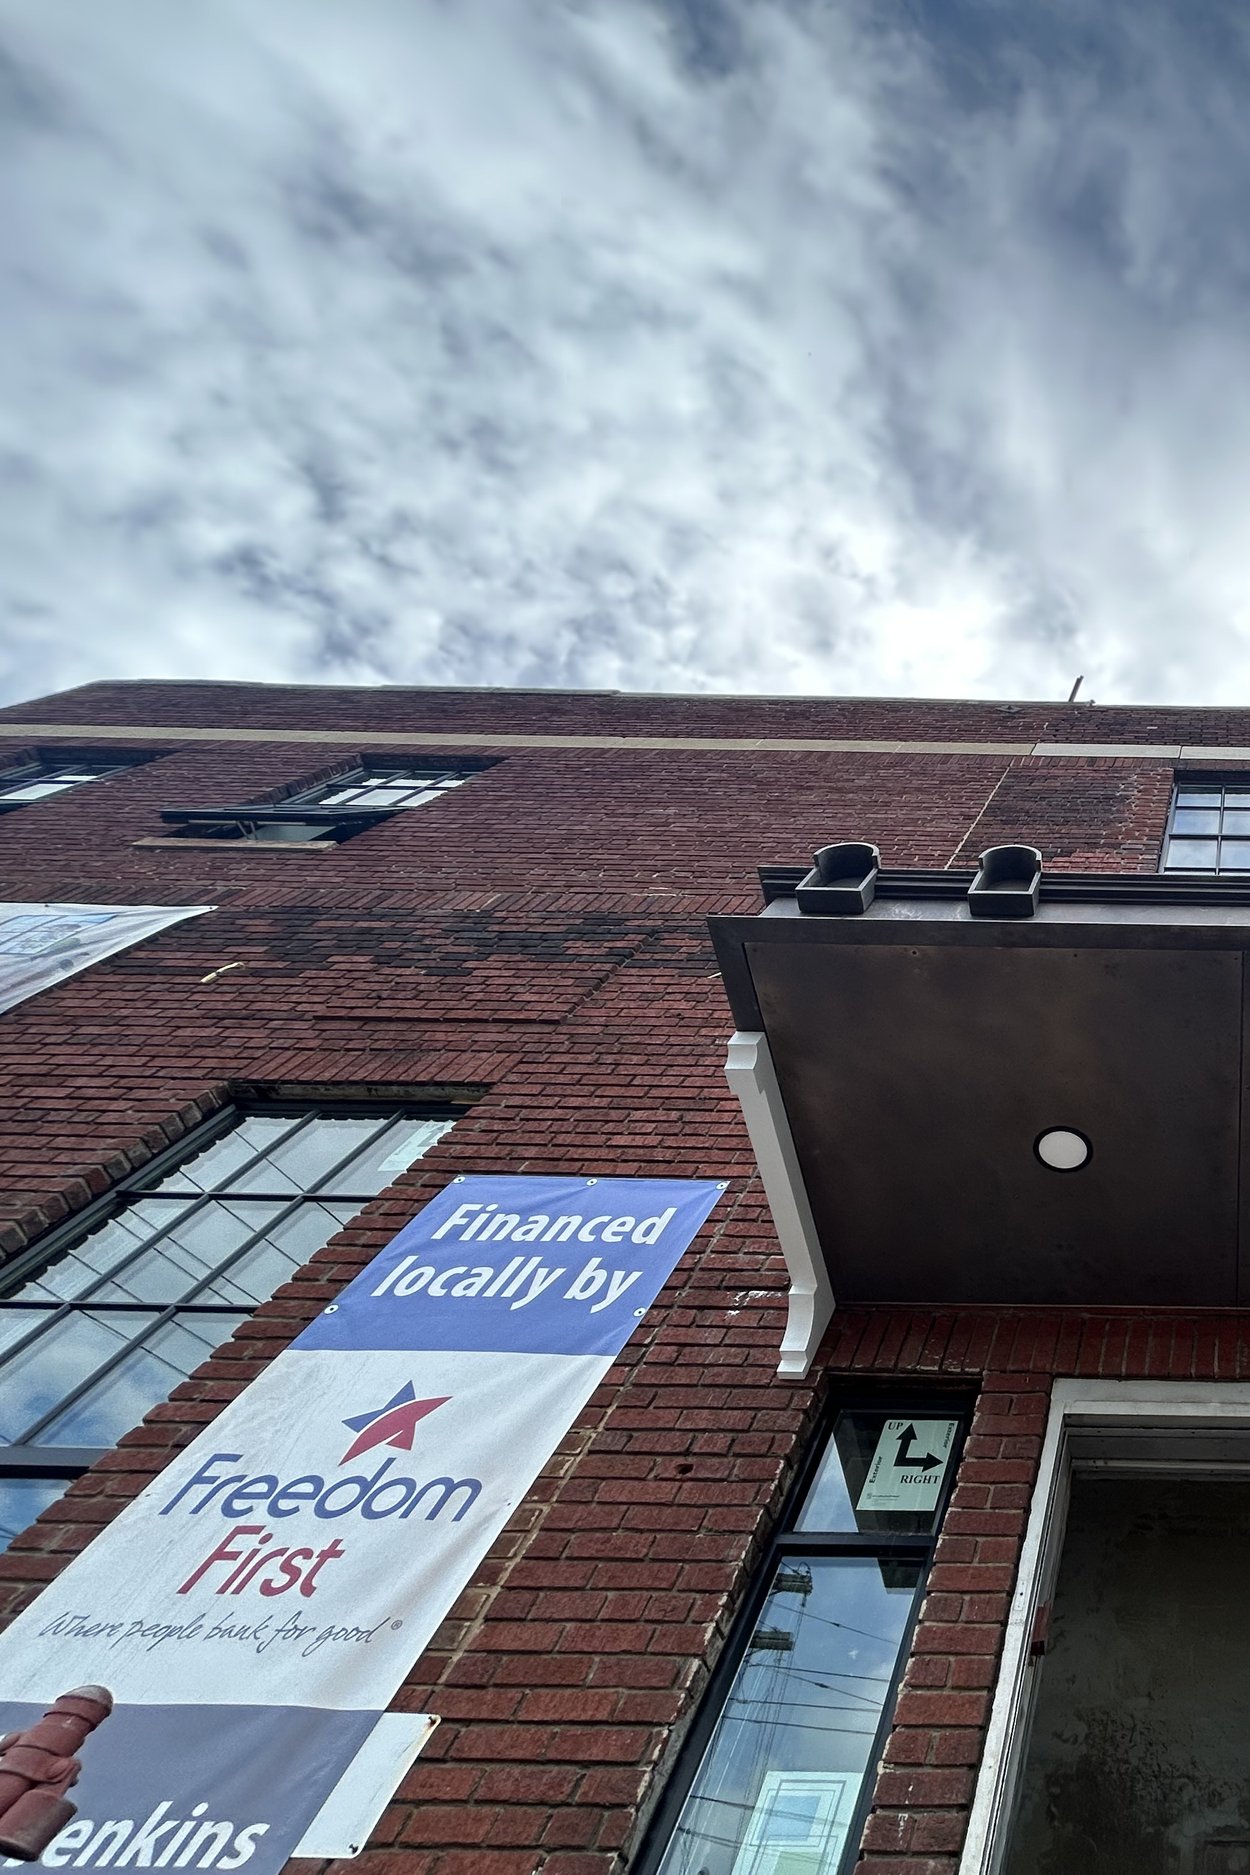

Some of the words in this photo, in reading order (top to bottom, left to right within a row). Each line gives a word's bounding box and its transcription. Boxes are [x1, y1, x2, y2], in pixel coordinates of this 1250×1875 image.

[431, 1203, 678, 1245] Financed
[370, 1255, 567, 1311] locally
[563, 1257, 643, 1314] by
[887, 1422, 904, 1430] UP
[158, 1453, 482, 1522] Freedom
[869, 1456, 882, 1483] Exterior
[900, 1475, 940, 1484] RIGHT
[176, 1525, 345, 1598] First
[38, 1611, 124, 1638] Where
[110, 1612, 207, 1652] people
[203, 1612, 266, 1641] bank
[256, 1610, 316, 1653] for
[3, 1801, 271, 1870] enkins
